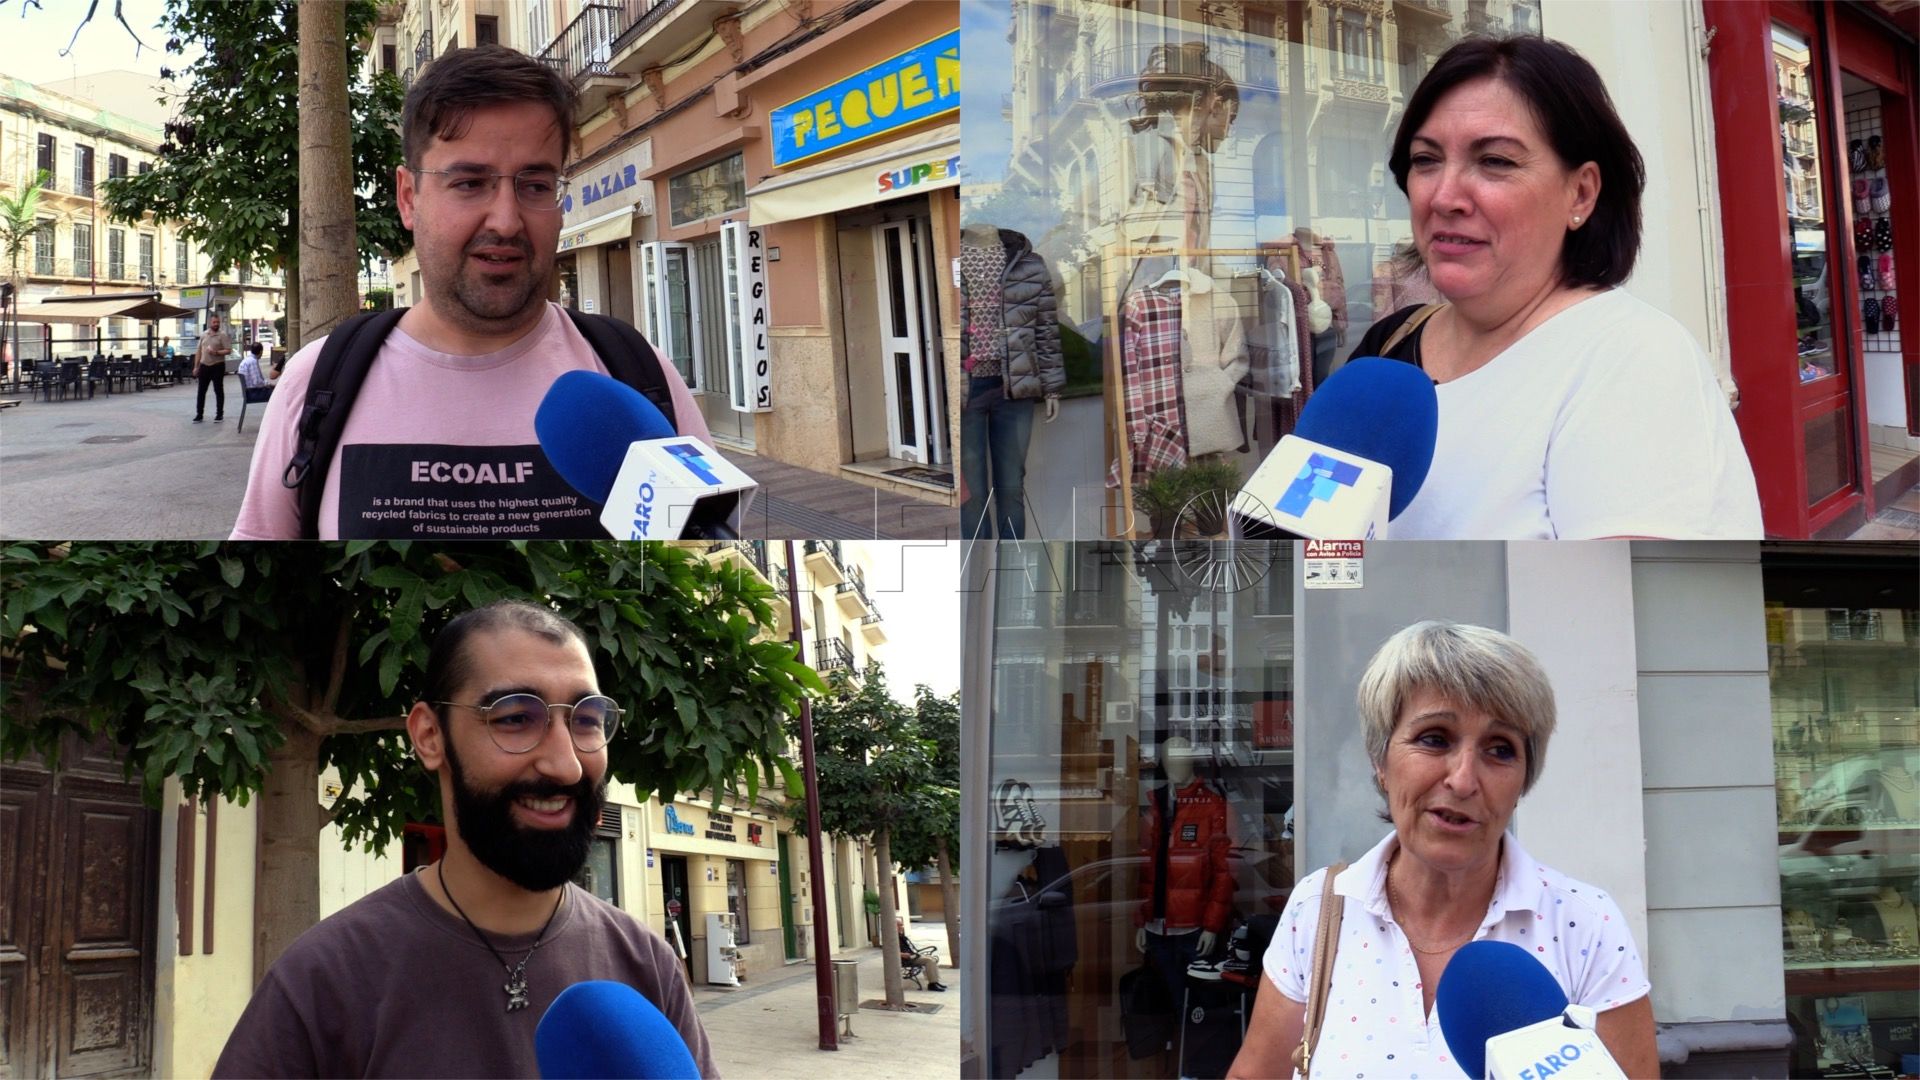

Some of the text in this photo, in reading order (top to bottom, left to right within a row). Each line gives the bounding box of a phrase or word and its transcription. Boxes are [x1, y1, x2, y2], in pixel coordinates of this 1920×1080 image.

[582, 164, 637, 206] BAZAR
[749, 230, 769, 403] REGALOS
[411, 461, 534, 484] ECOALF
[373, 495, 578, 510] is a brand that uses the highest quality
[362, 507, 592, 522] recycled fabrics to create a new generation
[412, 523, 541, 536] of sustainable products
[1306, 540, 1361, 551] Alarma
[1518, 1044, 1581, 1080] FARO
